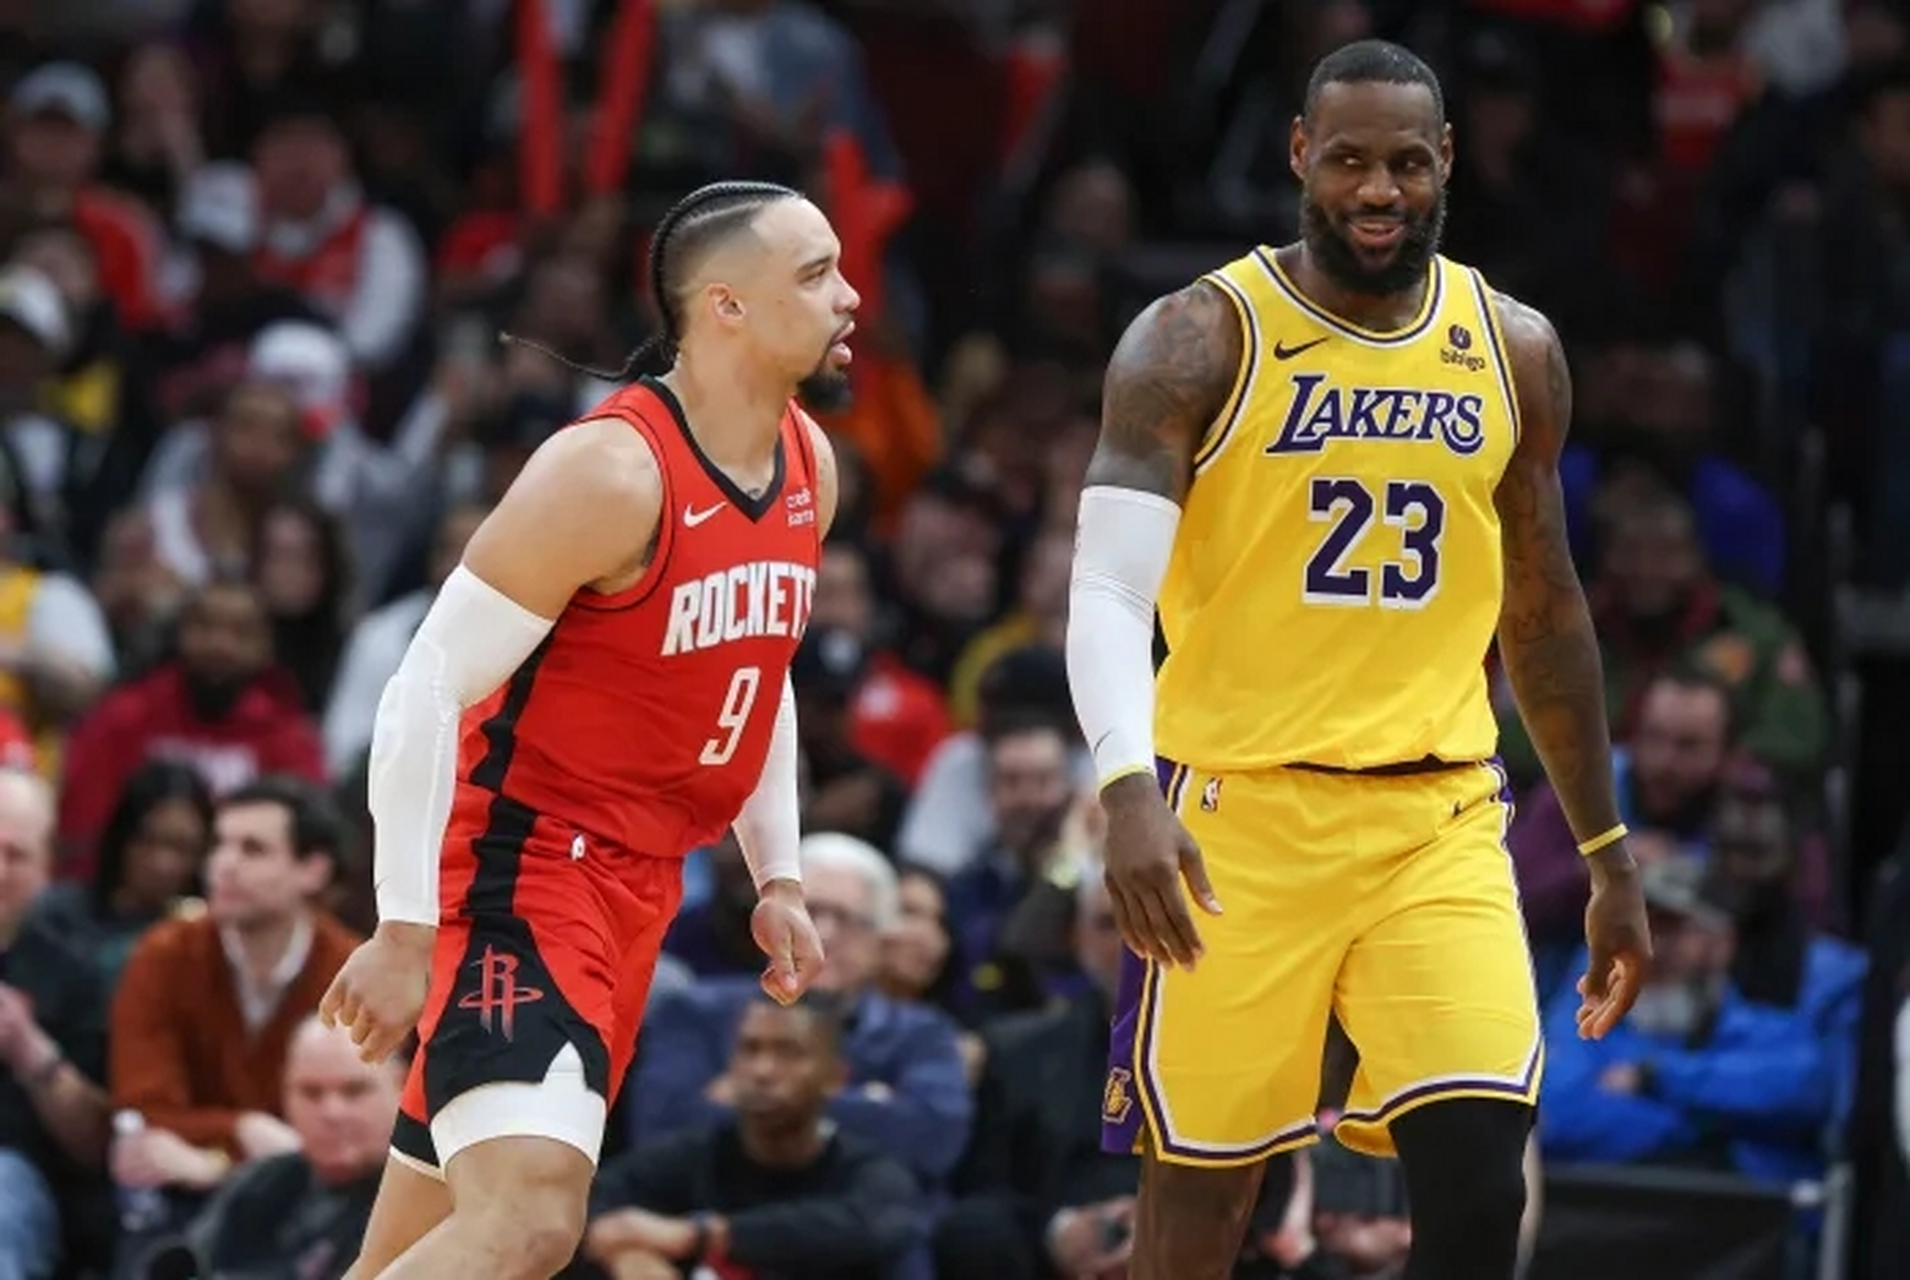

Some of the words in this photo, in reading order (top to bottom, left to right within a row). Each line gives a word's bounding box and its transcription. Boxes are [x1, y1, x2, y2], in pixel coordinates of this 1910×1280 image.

[1265, 373, 1485, 455] LAKERS
[1302, 477, 1447, 609] 23
[699, 667, 761, 765] 9
